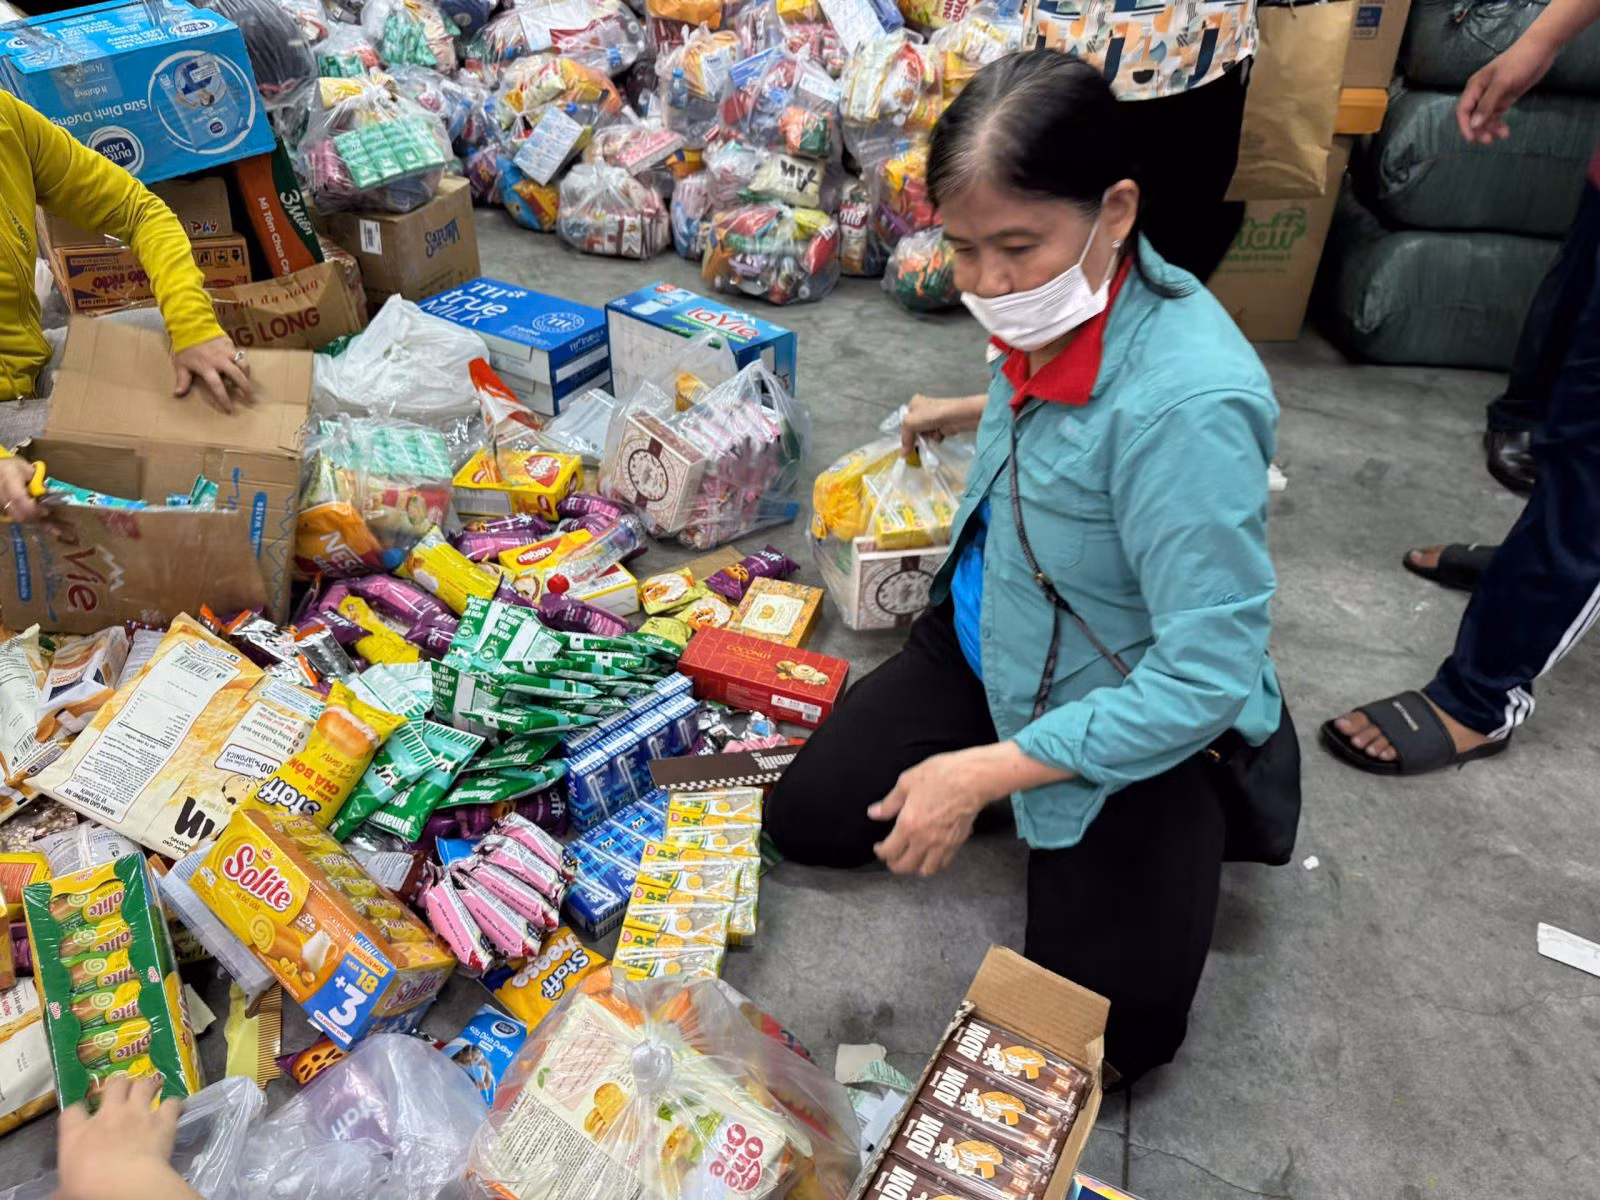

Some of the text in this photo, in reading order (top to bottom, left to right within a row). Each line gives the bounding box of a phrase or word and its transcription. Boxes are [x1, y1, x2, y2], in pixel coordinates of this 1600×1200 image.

[98, 105, 123, 118] Dinh
[124, 99, 148, 112] Sữa
[102, 141, 127, 153] LADY
[106, 148, 132, 161] DUTC
[263, 210, 276, 233] Tôm
[271, 232, 285, 259] Chua
[1237, 207, 1307, 251] taff
[425, 299, 490, 326] MILK
[440, 288, 508, 317] true
[257, 307, 320, 343] LONG
[226, 751, 256, 770] JAPONICA
[224, 842, 293, 913] Solite
[88, 890, 125, 917] olite
[97, 930, 131, 953] olite
[102, 964, 138, 987] olite
[353, 969, 380, 995] 18
[540, 948, 591, 1001] Staff
[111, 999, 139, 1020] lite
[115, 1032, 152, 1059] olite
[479, 1030, 497, 1046] Dinh
[490, 1039, 515, 1059] Dưỡng
[955, 1022, 991, 1062] ADM
[932, 1066, 969, 1108] ADM
[905, 1113, 945, 1160] ADM
